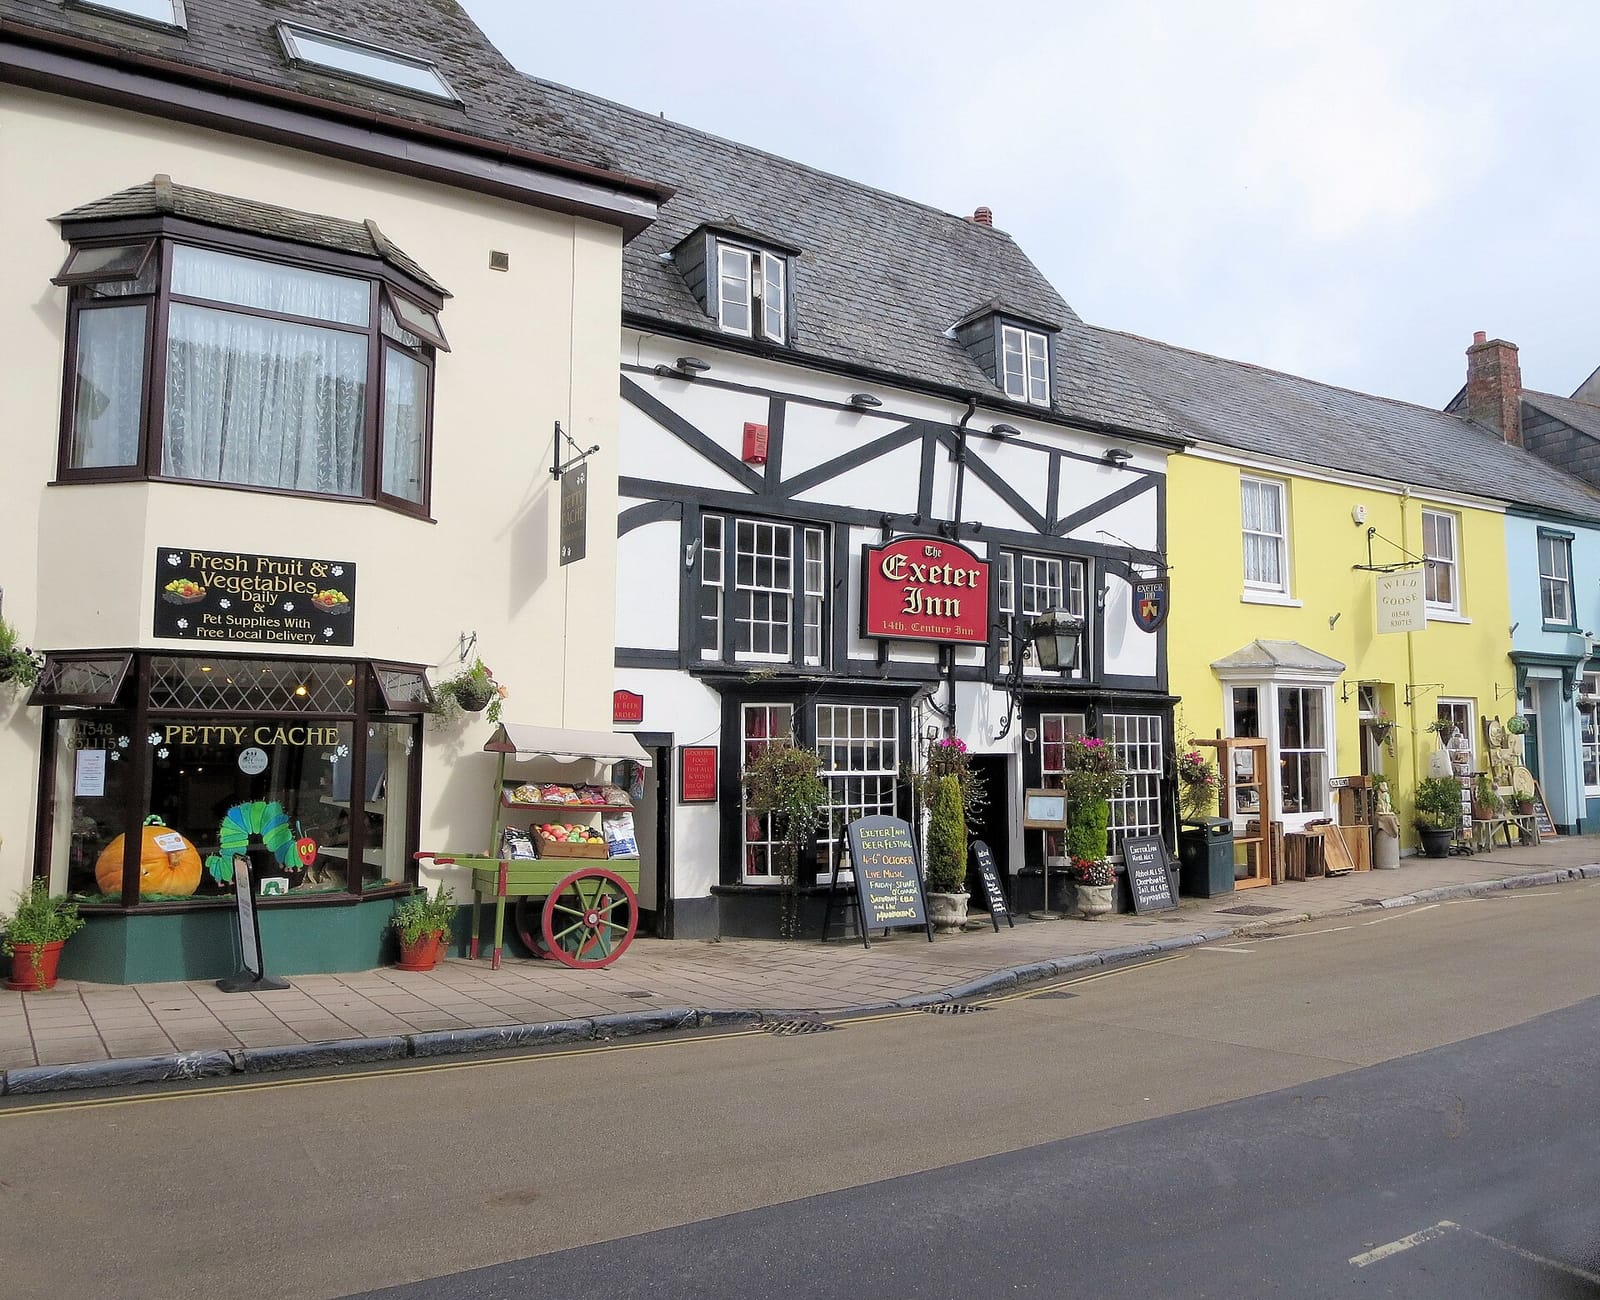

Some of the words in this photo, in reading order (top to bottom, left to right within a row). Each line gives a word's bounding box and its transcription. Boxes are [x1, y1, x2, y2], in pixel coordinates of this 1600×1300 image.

[924, 545, 942, 559] The
[189, 552, 248, 572] Fresh
[256, 557, 304, 576] Fruit
[309, 561, 328, 578] &
[882, 553, 980, 588] Exeter
[200, 571, 317, 594] Vegetables
[1136, 583, 1164, 593] EXETER
[1383, 579, 1417, 590] WILD
[241, 590, 278, 605] Daily
[902, 586, 961, 618] Inn
[1382, 593, 1417, 605] GOOSE
[253, 603, 265, 613] &
[203, 614, 222, 625] Pet
[226, 615, 281, 630] Supplies
[284, 617, 311, 628] With
[911, 622, 952, 634] Century
[954, 625, 974, 636] Inn
[196, 627, 224, 637] Free
[228, 628, 263, 639] Local
[266, 629, 316, 643] Delivery
[165, 725, 246, 745] PETTY
[254, 727, 340, 746] CACHE
[860, 827, 891, 838] EXETER
[862, 840, 884, 850] BEER
[882, 855, 914, 865] OCTOBER
[865, 869, 881, 879] LIVE
[883, 869, 905, 878] MUSIC
